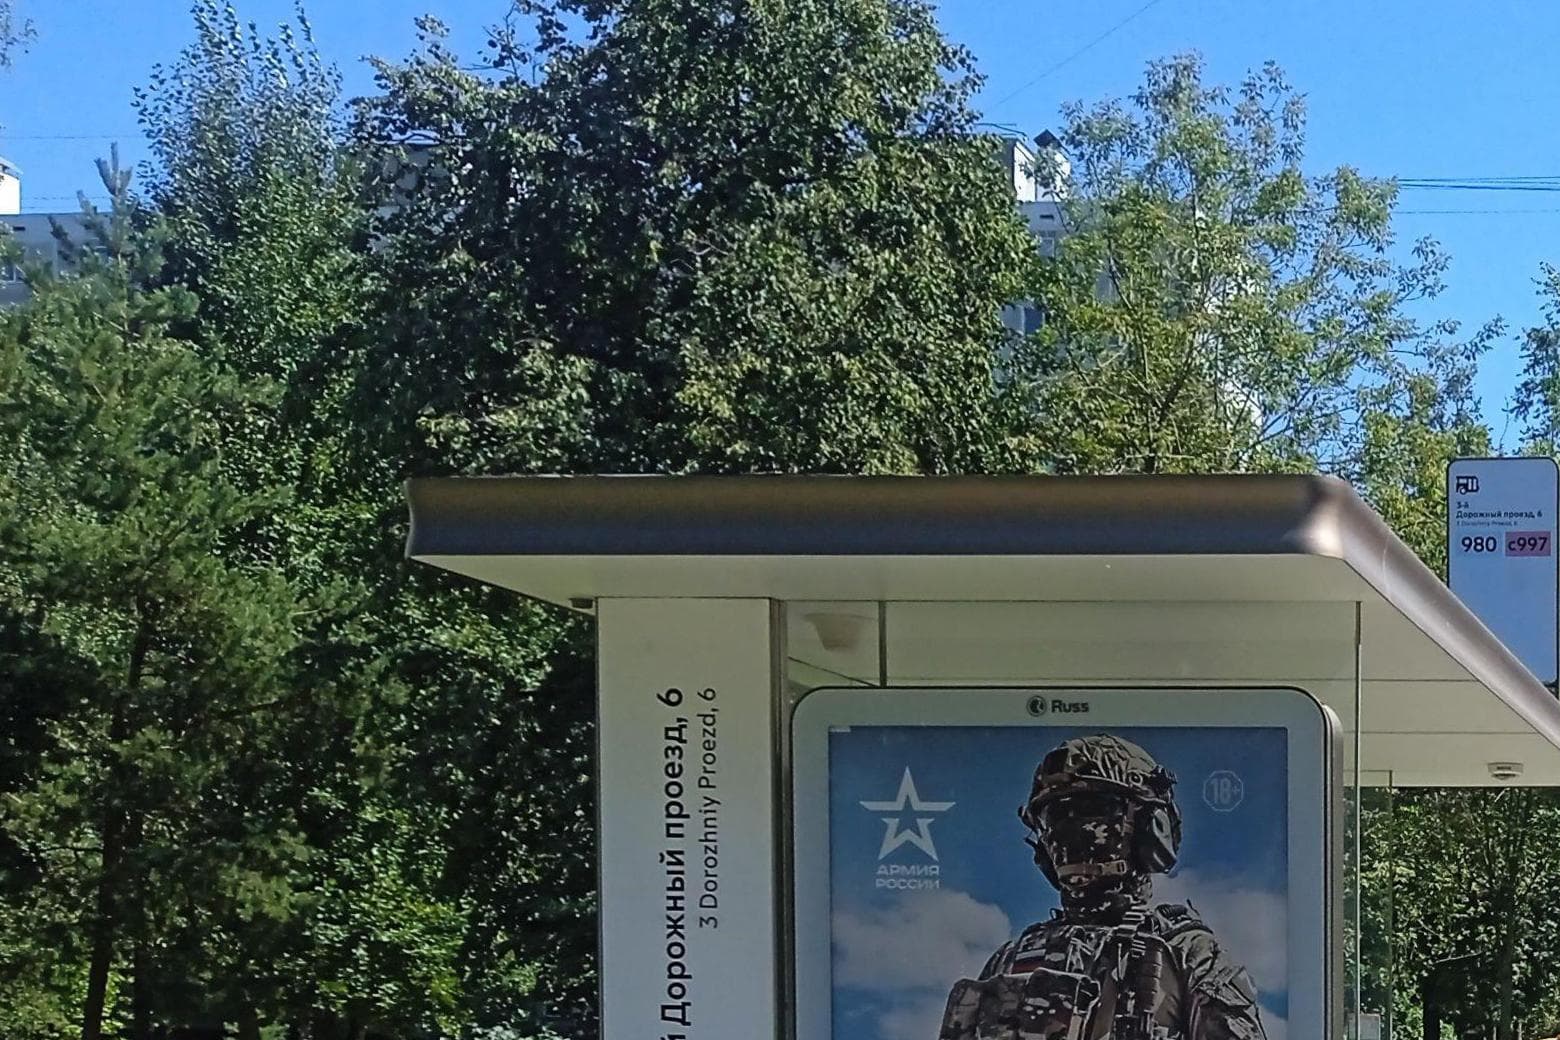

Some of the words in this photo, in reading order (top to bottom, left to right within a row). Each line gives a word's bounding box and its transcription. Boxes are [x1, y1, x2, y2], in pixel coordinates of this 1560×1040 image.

[1456, 510, 1502, 519] Дорожный
[1461, 536, 1497, 553] 980
[1508, 536, 1548, 552] с997
[656, 688, 683, 707] 6
[697, 688, 716, 701] 6
[1051, 699, 1089, 713] Russ
[697, 708, 719, 789] Proezd,
[664, 717, 690, 838] проезд,
[1210, 778, 1241, 805] 18+
[698, 796, 721, 909] Dorozhniy
[876, 865, 940, 876] АРМИЯ
[876, 879, 940, 889] РОССИИ
[699, 916, 718, 929] 3
[659, 850, 692, 1027] Дорожный
